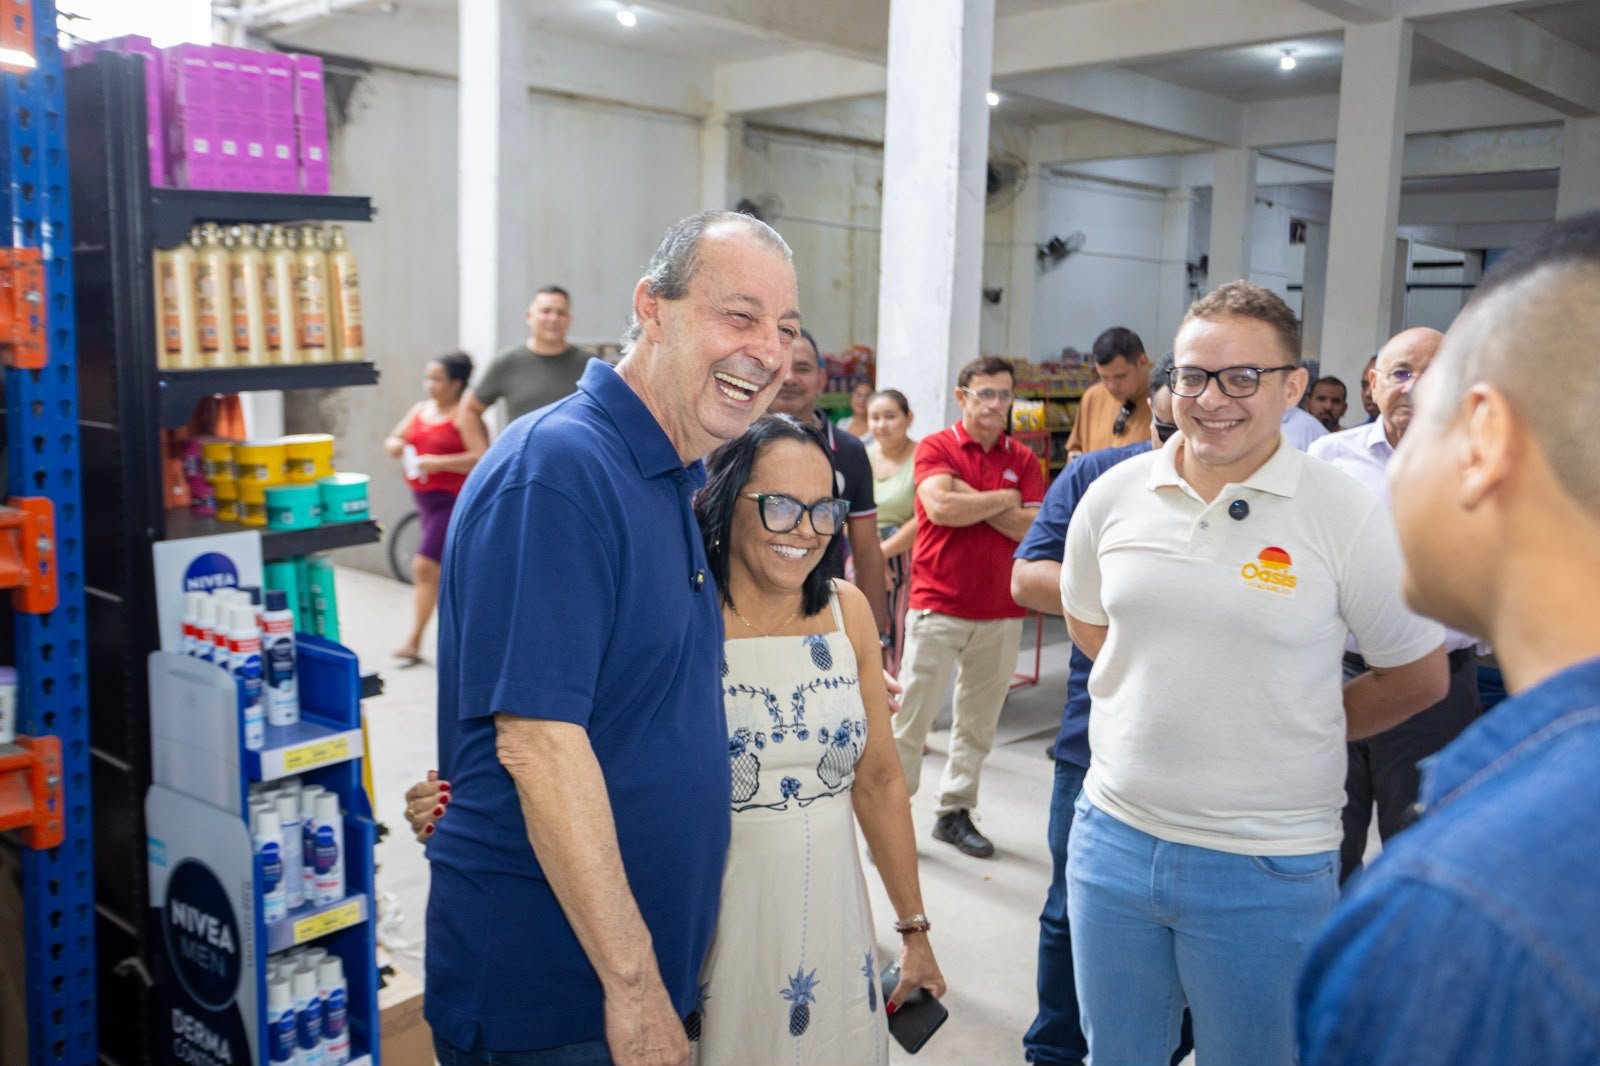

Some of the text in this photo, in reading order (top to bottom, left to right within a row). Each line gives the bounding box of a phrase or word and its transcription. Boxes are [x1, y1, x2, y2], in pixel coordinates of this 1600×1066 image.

[186, 573, 236, 591] NIVEA
[1240, 562, 1297, 589] Oasis
[171, 899, 235, 954] NIVEA
[180, 935, 226, 977] MEN
[172, 1007, 232, 1064] DERMA
